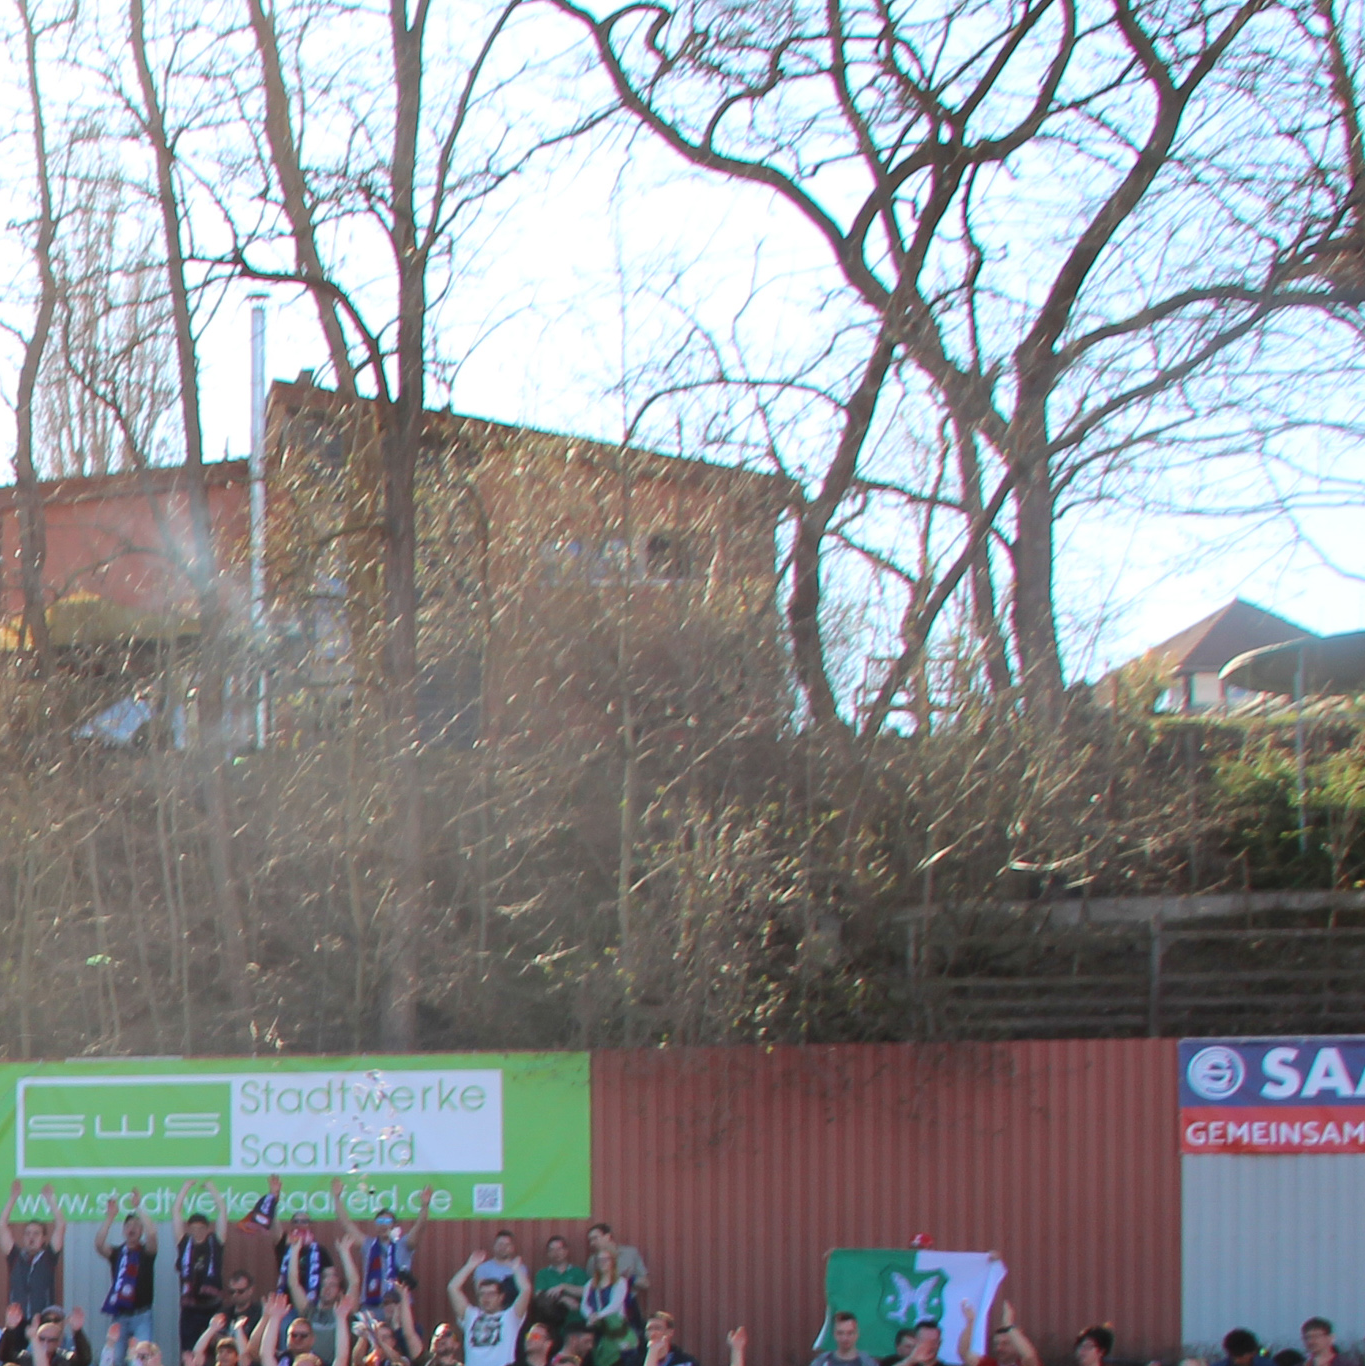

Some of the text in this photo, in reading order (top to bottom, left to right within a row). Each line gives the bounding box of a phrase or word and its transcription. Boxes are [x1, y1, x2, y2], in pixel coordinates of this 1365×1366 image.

[1259, 1046, 1365, 1100] SA
[240, 1078, 487, 1114] Stadtwerke
[241, 1133, 415, 1167] Saalfeld
